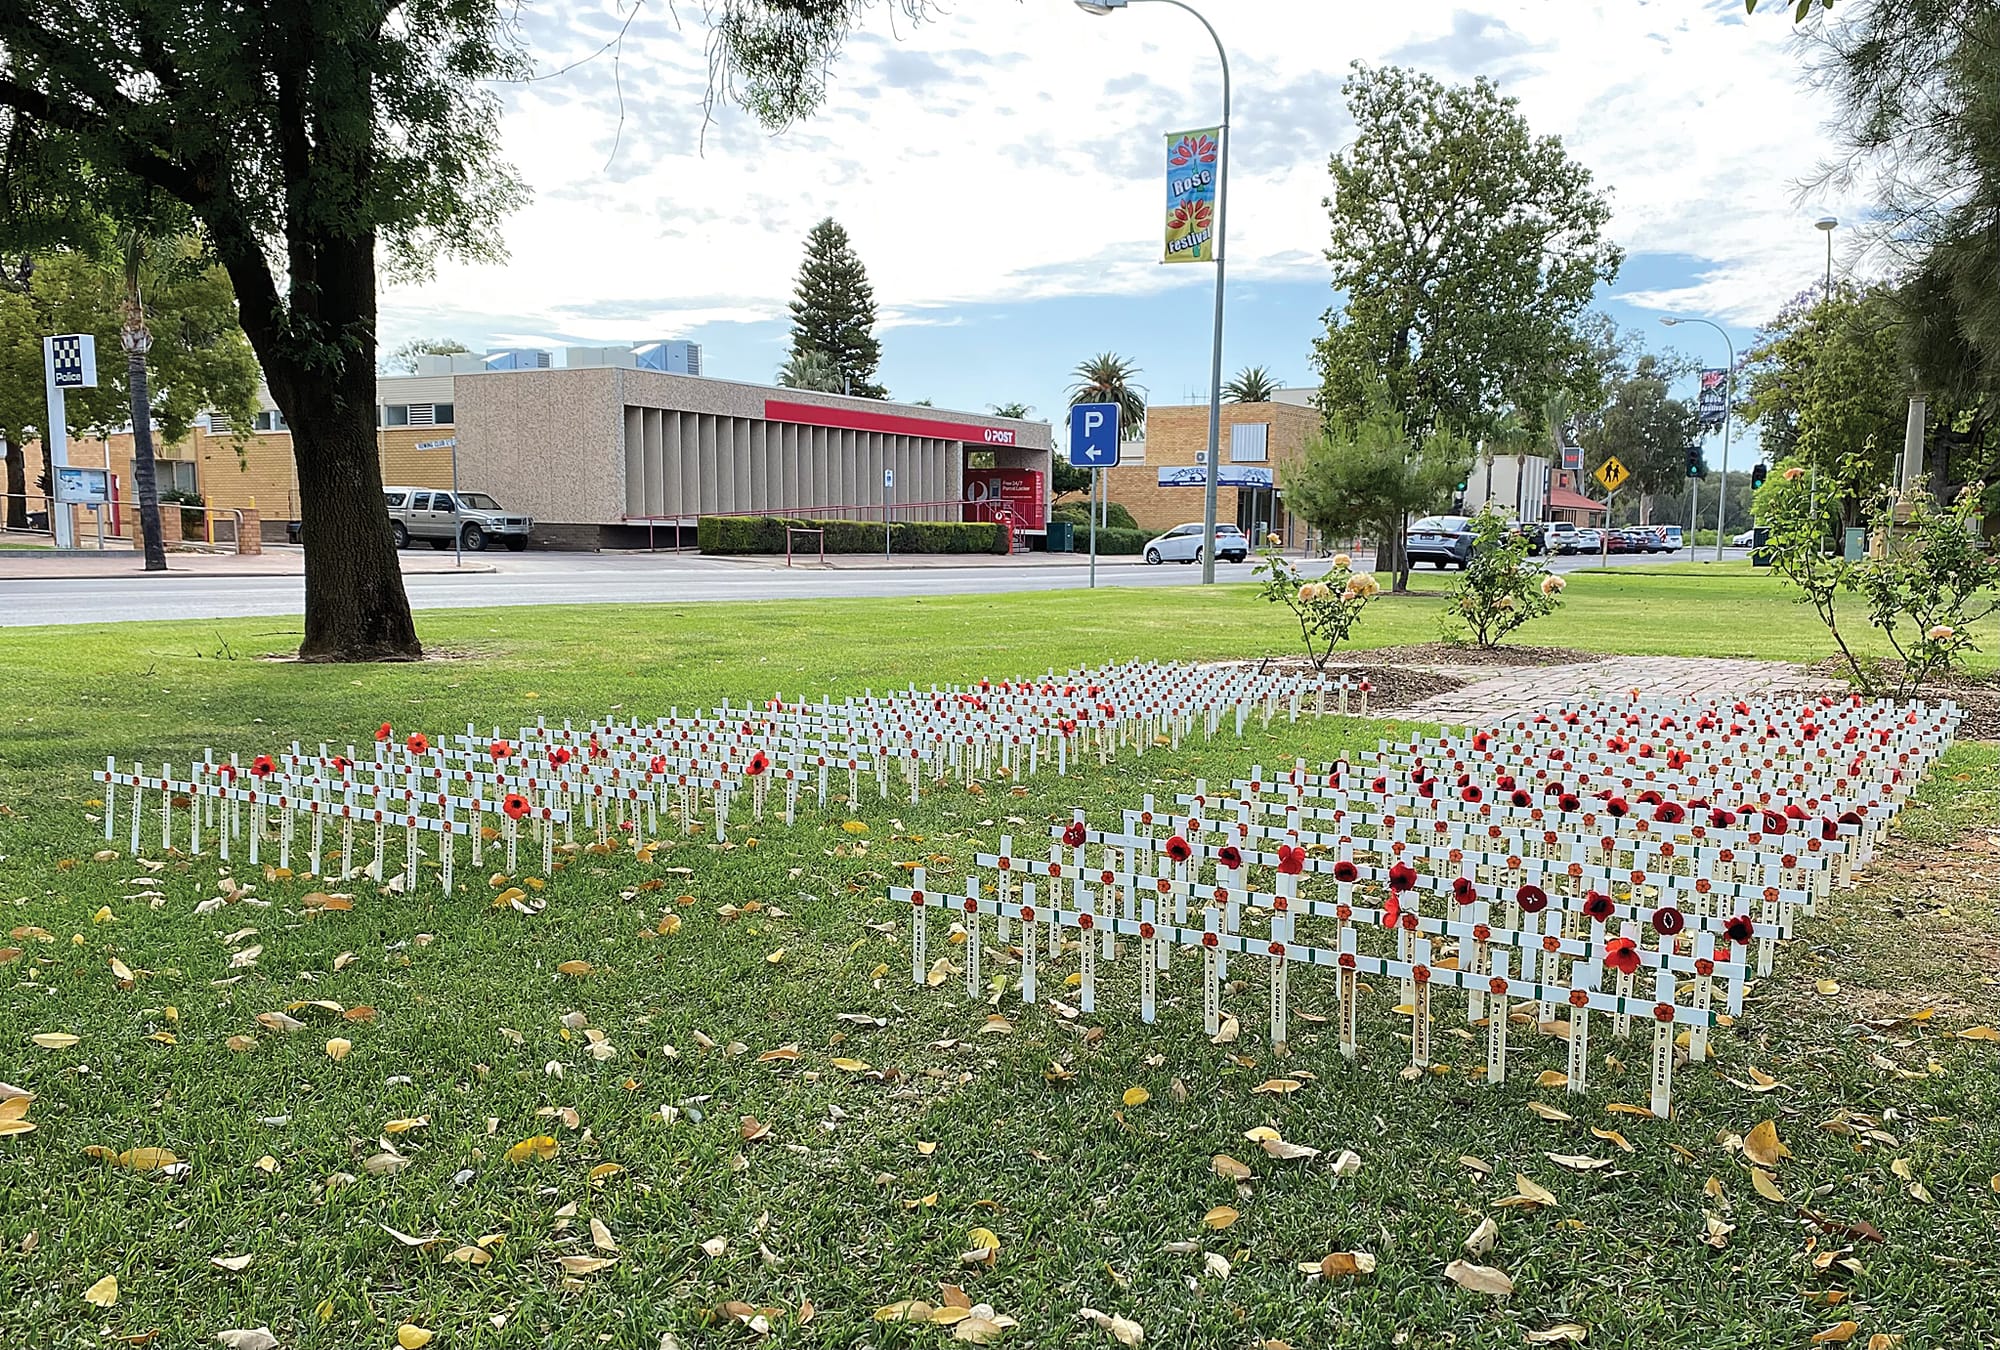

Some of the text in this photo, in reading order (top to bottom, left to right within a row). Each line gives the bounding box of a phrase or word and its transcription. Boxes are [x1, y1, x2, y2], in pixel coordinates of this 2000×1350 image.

[1172, 169, 1211, 197] Rose
[1168, 229, 1210, 255] Festival
[55, 372, 81, 382] Police
[992, 430, 1013, 443] POST
[1085, 411, 1103, 438] P
[1492, 1021, 1500, 1065] GOLDNER
[1574, 1034, 1582, 1073] GRIEVE
[1657, 1046, 1666, 1086] GREENE
